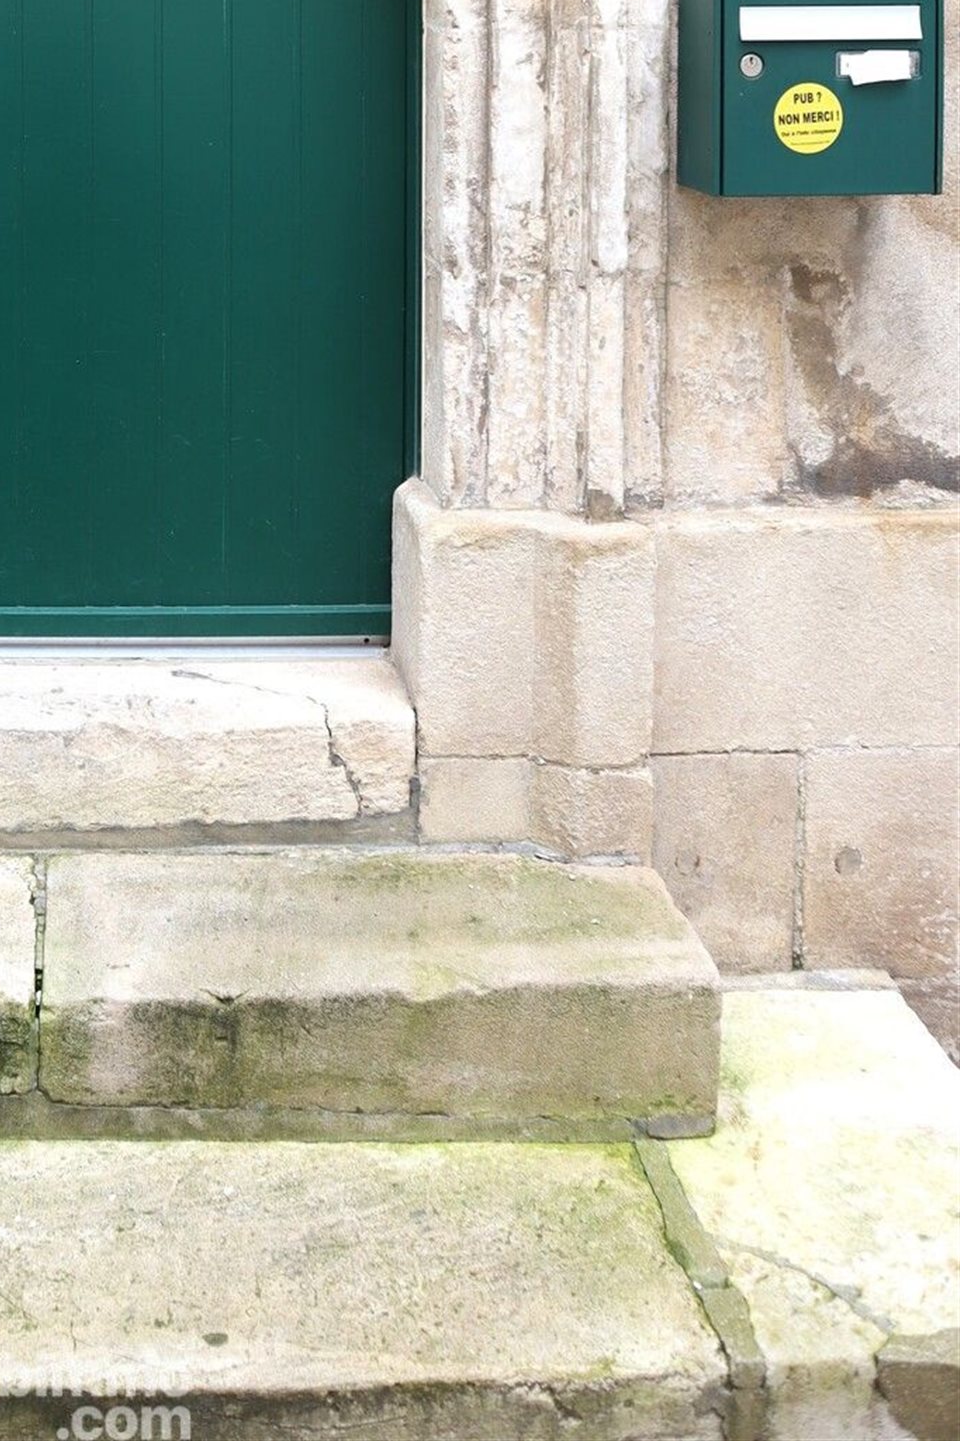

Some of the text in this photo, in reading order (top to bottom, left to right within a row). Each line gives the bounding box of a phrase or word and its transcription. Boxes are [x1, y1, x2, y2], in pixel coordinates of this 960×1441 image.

[793, 92, 814, 104] PUB
[778, 113, 800, 125] NON
[803, 110, 834, 123] MERCI
